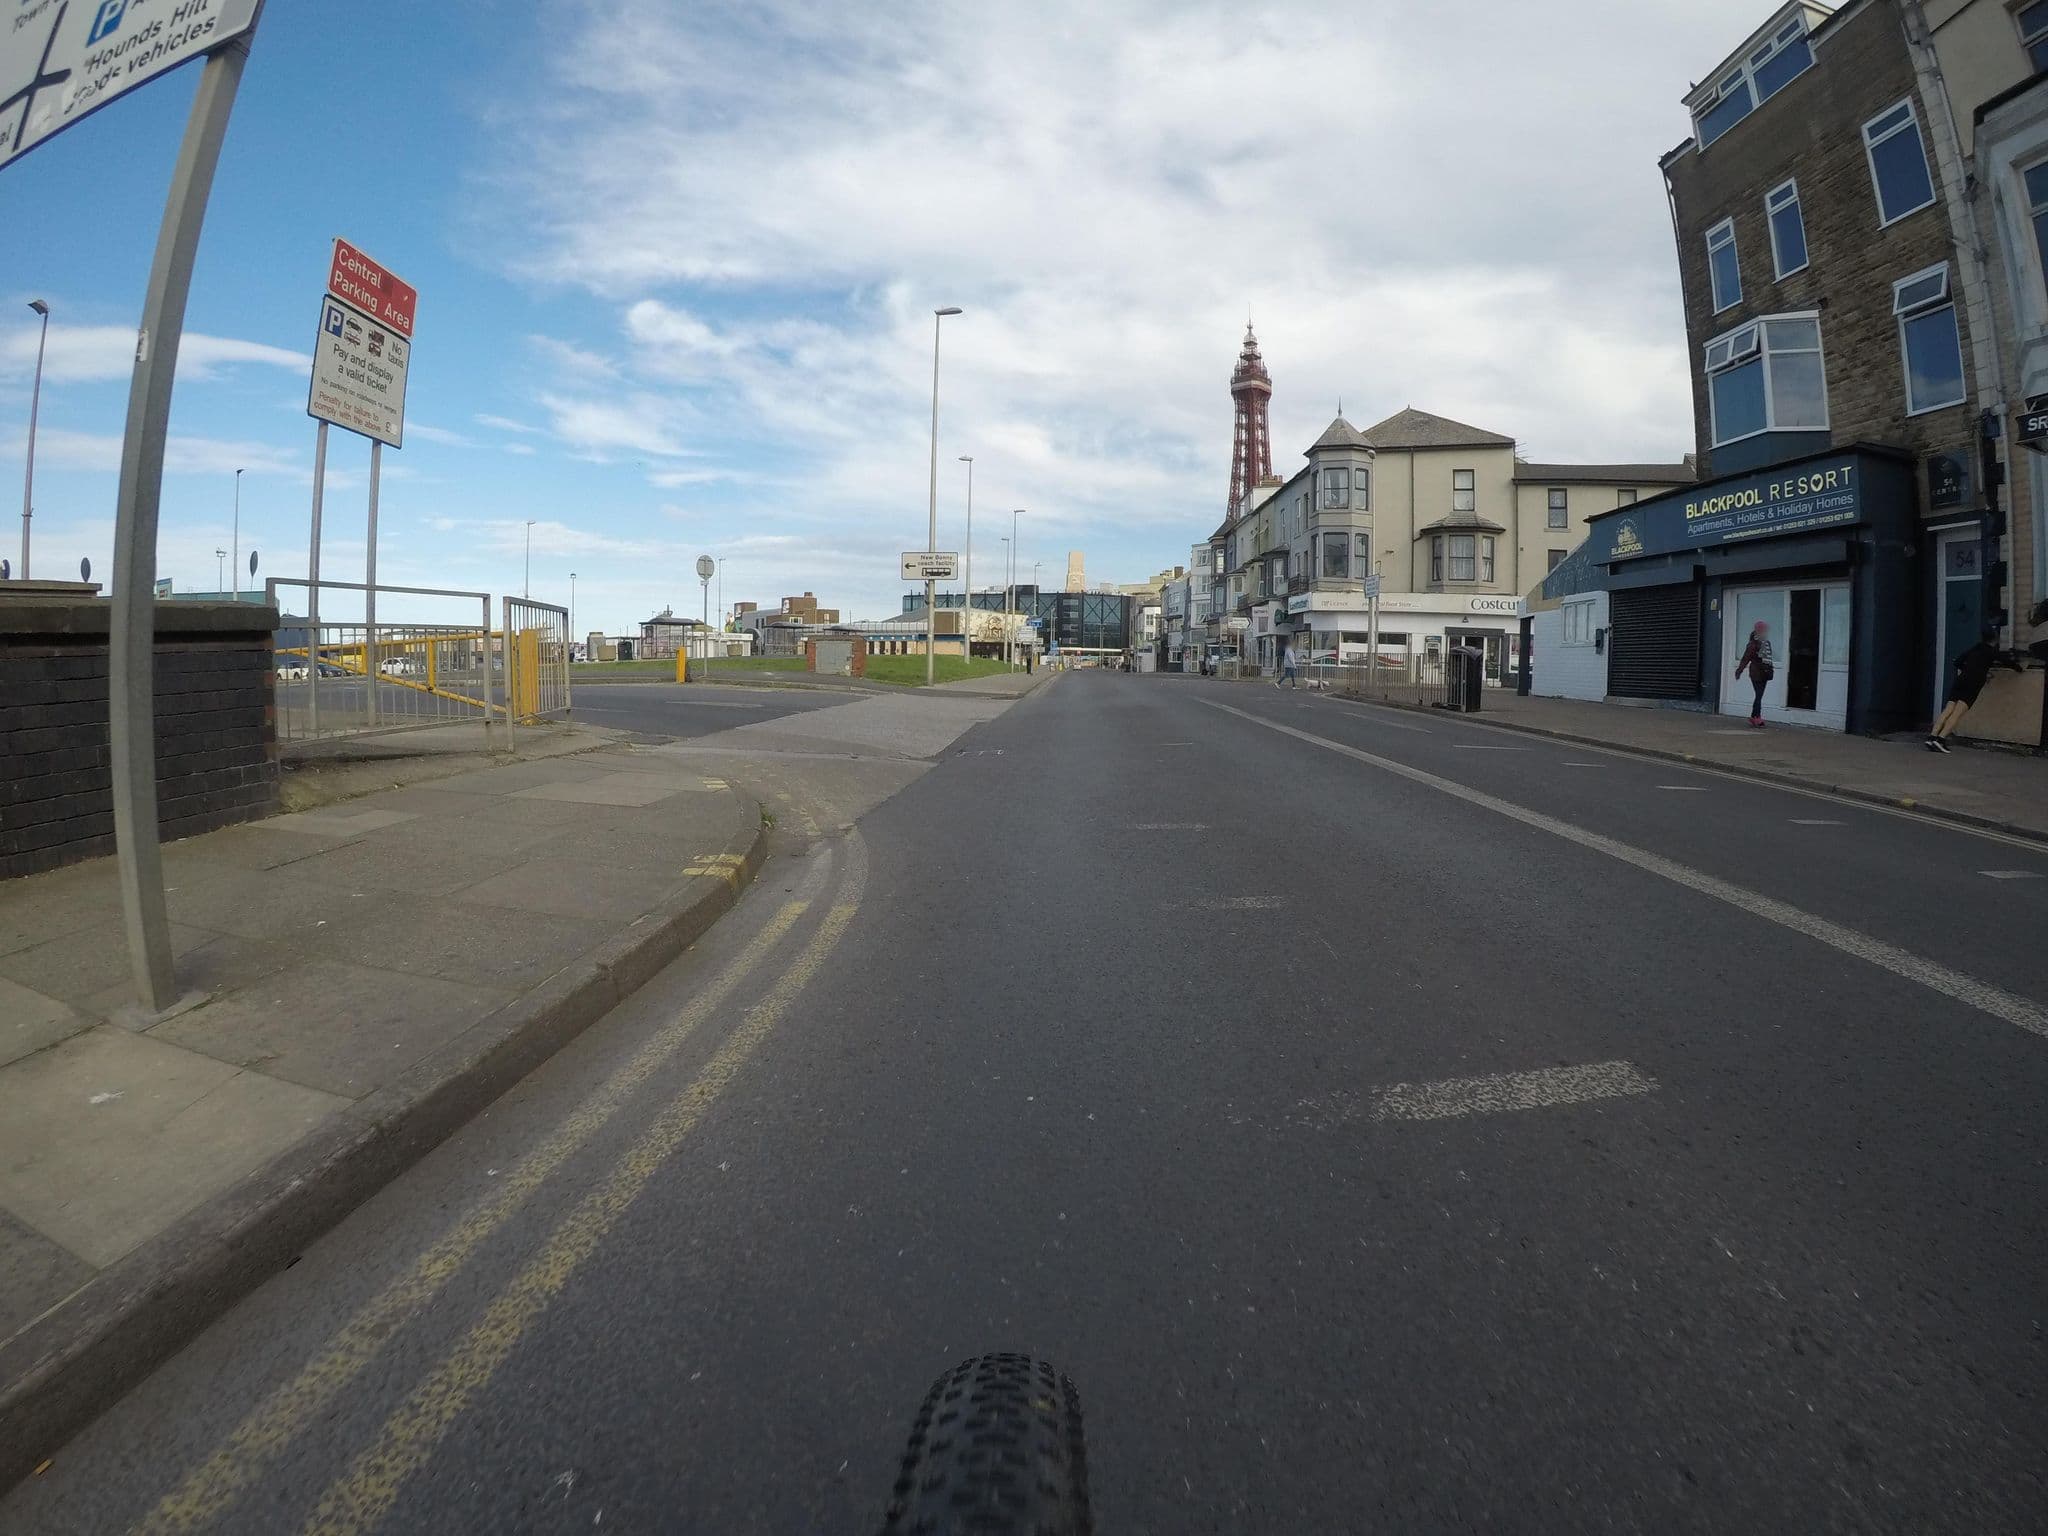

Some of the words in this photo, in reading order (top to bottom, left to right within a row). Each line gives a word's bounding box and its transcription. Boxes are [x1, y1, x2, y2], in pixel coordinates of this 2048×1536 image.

[87, 20, 163, 74] Hounds
[170, 0, 208, 28] Hill
[128, 16, 216, 73] vehicles
[338, 248, 382, 289] Central
[333, 270, 378, 313] Parking
[384, 302, 410, 330] Area
[333, 343, 349, 362] Pay
[350, 354, 366, 368] and
[367, 362, 394, 385] display
[387, 352, 405, 369] taxis
[392, 342, 402, 356] No
[319, 391, 342, 408] Penalty
[338, 364, 344, 374] a
[346, 367, 366, 383] valid
[366, 375, 388, 394] ticket
[314, 401, 337, 417] comply
[1686, 488, 1763, 519] BLACKPOOL
[1769, 466, 1852, 501] RESORT
[1687, 517, 1735, 535] Apartments,
[1737, 510, 1765, 524] Hotels
[1767, 507, 1774, 519] &
[1777, 502, 1813, 517] Holiday
[1816, 494, 1854, 510] Homes
